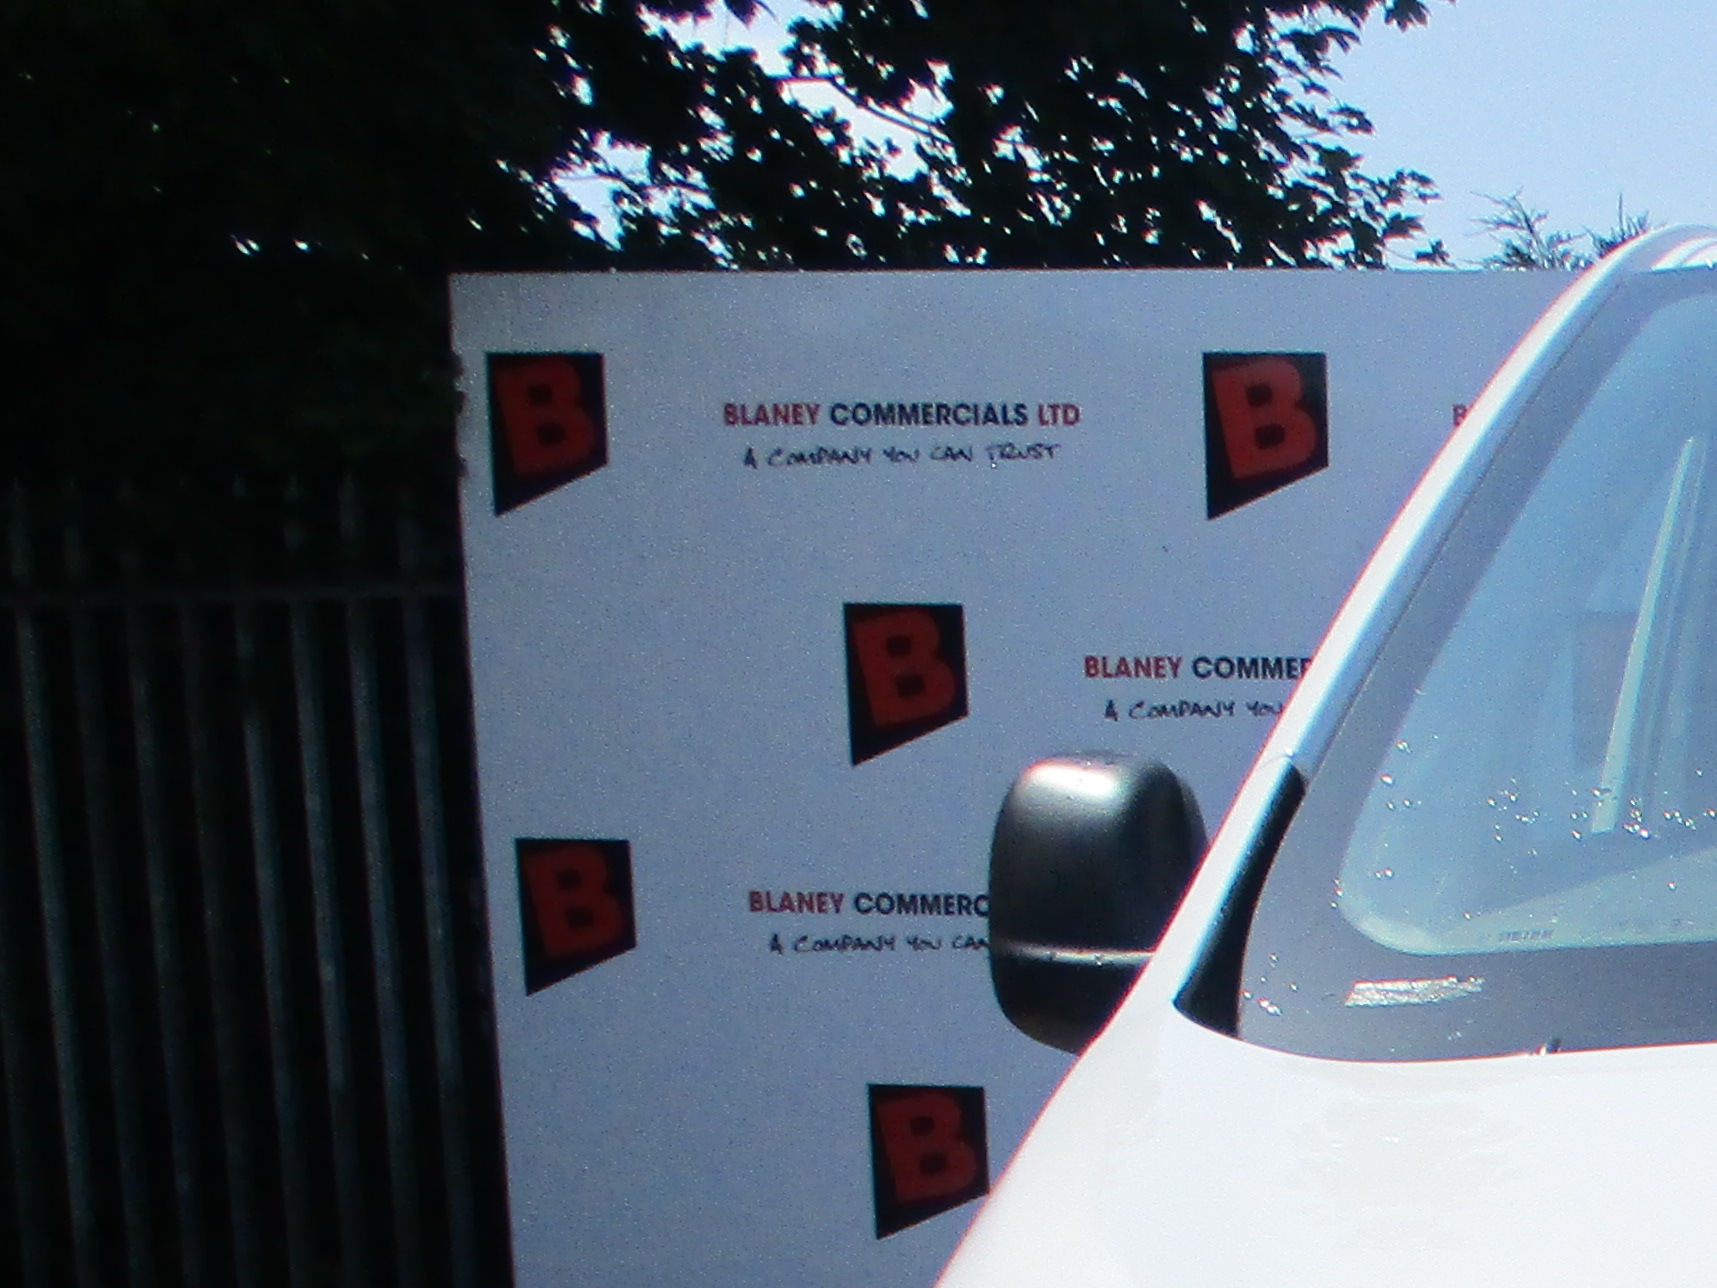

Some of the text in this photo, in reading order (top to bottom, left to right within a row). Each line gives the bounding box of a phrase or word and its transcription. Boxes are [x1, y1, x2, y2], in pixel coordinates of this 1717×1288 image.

[723, 402, 1080, 426] BLANEY COMMERCIALS LTD
[1212, 358, 1316, 479] B
[853, 610, 955, 725] B
[1084, 655, 1183, 679] BLANEY
[1128, 700, 1236, 719] COMPANY
[749, 890, 990, 917] BLANEY COMMERC
